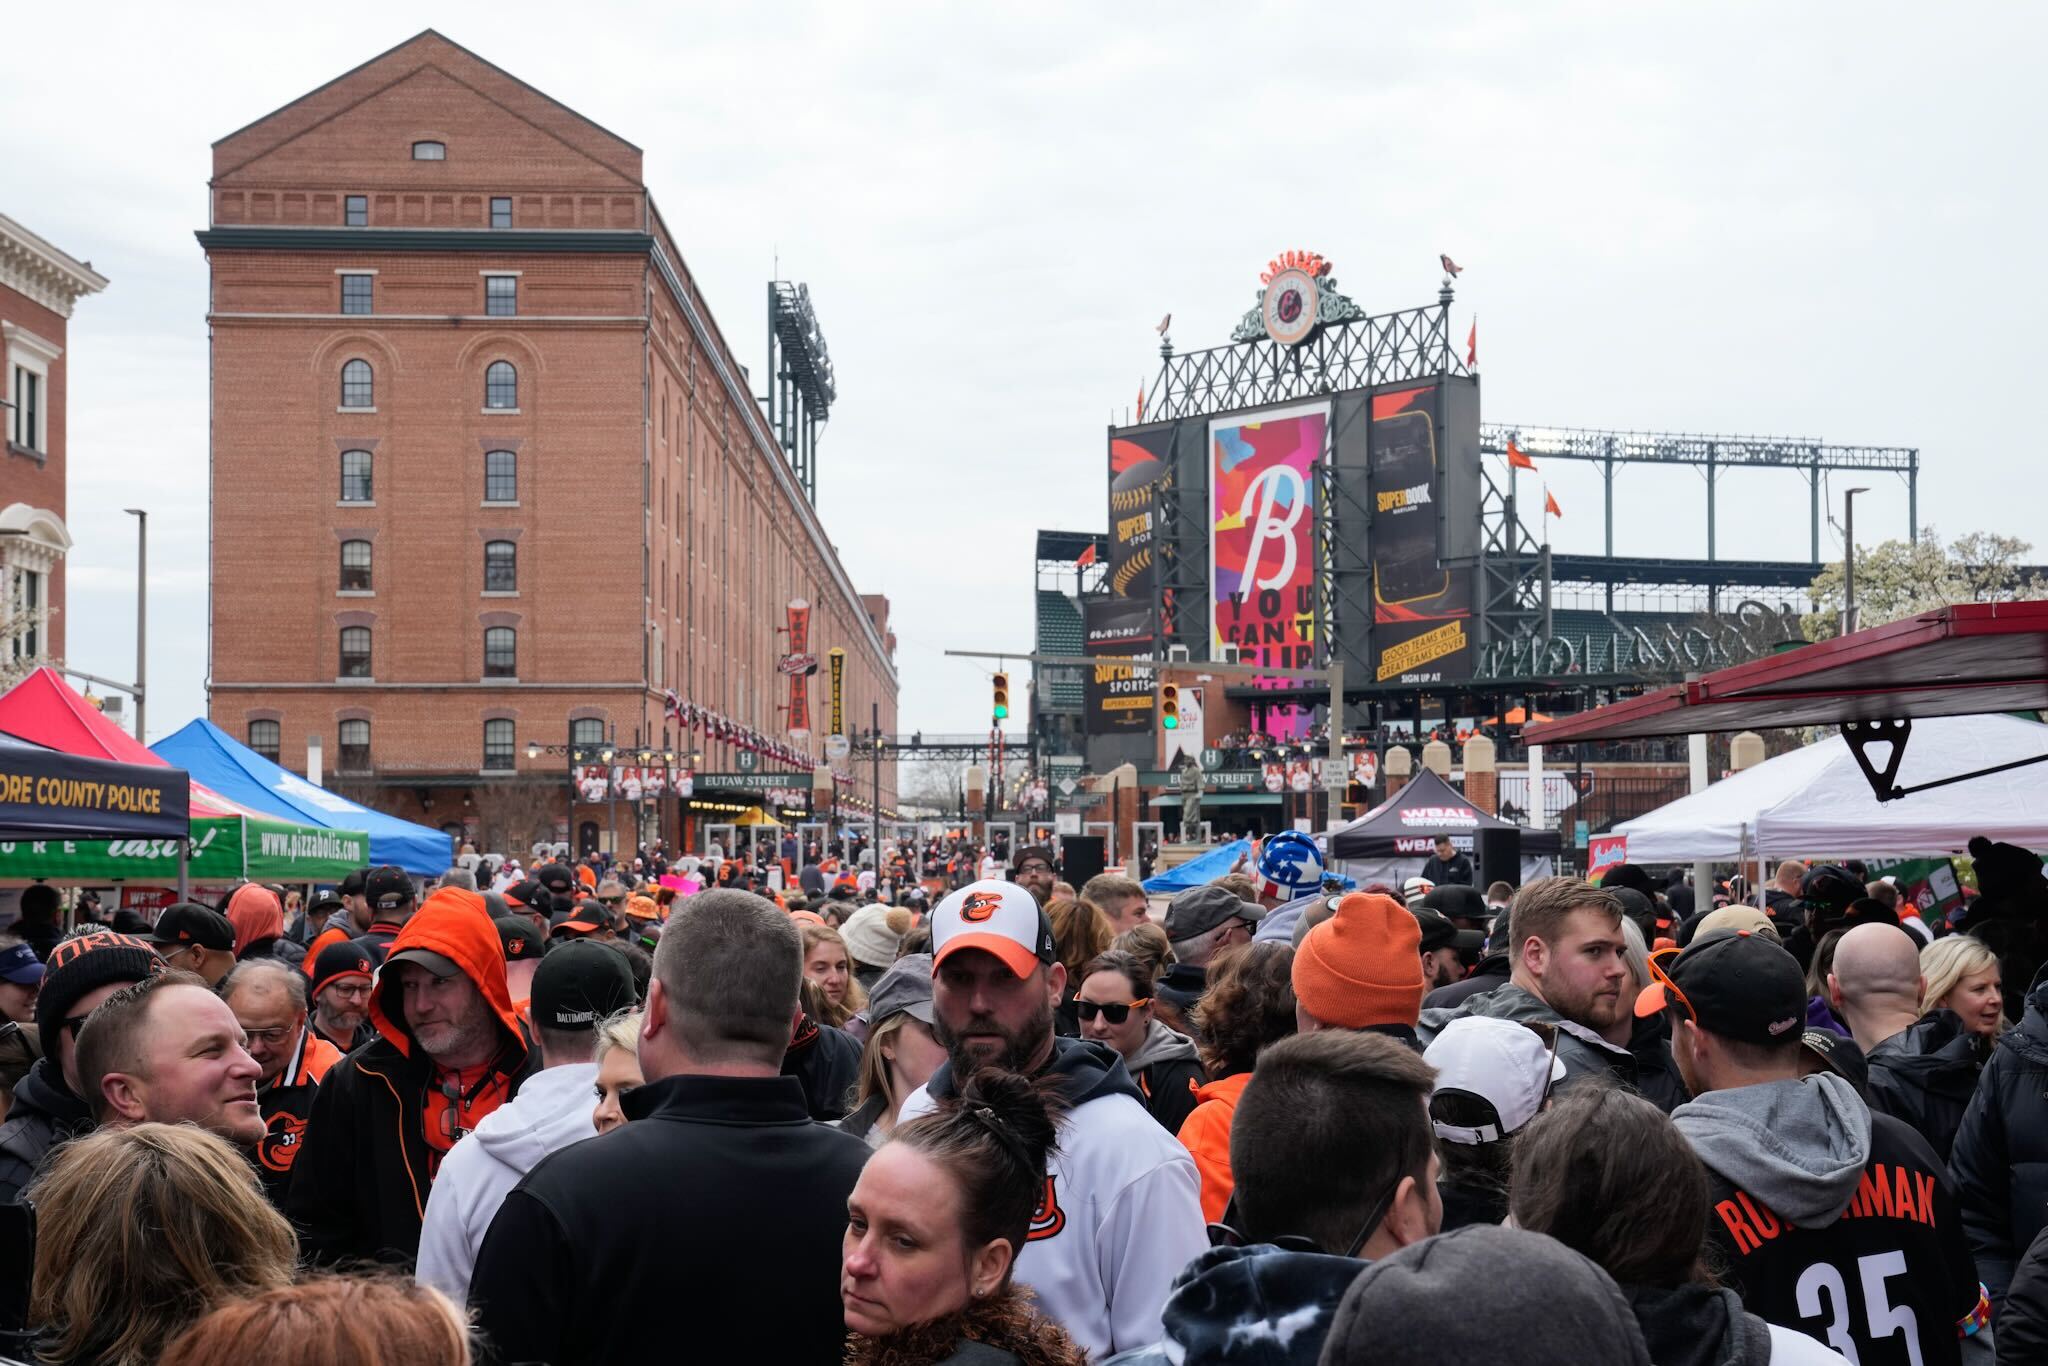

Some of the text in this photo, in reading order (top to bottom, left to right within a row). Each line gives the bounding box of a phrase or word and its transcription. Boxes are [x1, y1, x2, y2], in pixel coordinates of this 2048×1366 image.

[1377, 483, 1432, 513] SUPERBOOK
[1229, 585, 1313, 620] YOU
[1229, 620, 1313, 646] CAN'T
[1383, 625, 1457, 664] GOOD TEAMS WIN
[1095, 652, 1164, 684] SUPERBO
[1378, 636, 1464, 679] GREAT TEAMS COVER
[1110, 680, 1149, 693] SPORTS
[1401, 672, 1442, 683] SIGN UP AT
[833, 656, 841, 735] SUPERBOOK
[741, 752, 752, 766] H
[1206, 749, 1216, 761] H
[705, 775, 790, 786] EUTAW STREET
[1212, 772, 1254, 784] STREET
[36, 776, 105, 809] COUNTY
[107, 784, 161, 814] POLICE
[1402, 807, 1473, 818] WBAL
[261, 829, 361, 863] www.pizzabolis.com
[1396, 838, 1436, 852] WBA
[556, 1011, 594, 1023] BALTIMORE
[1715, 1163, 1935, 1256] RUMAN
[1796, 1250, 1924, 1366] 35
